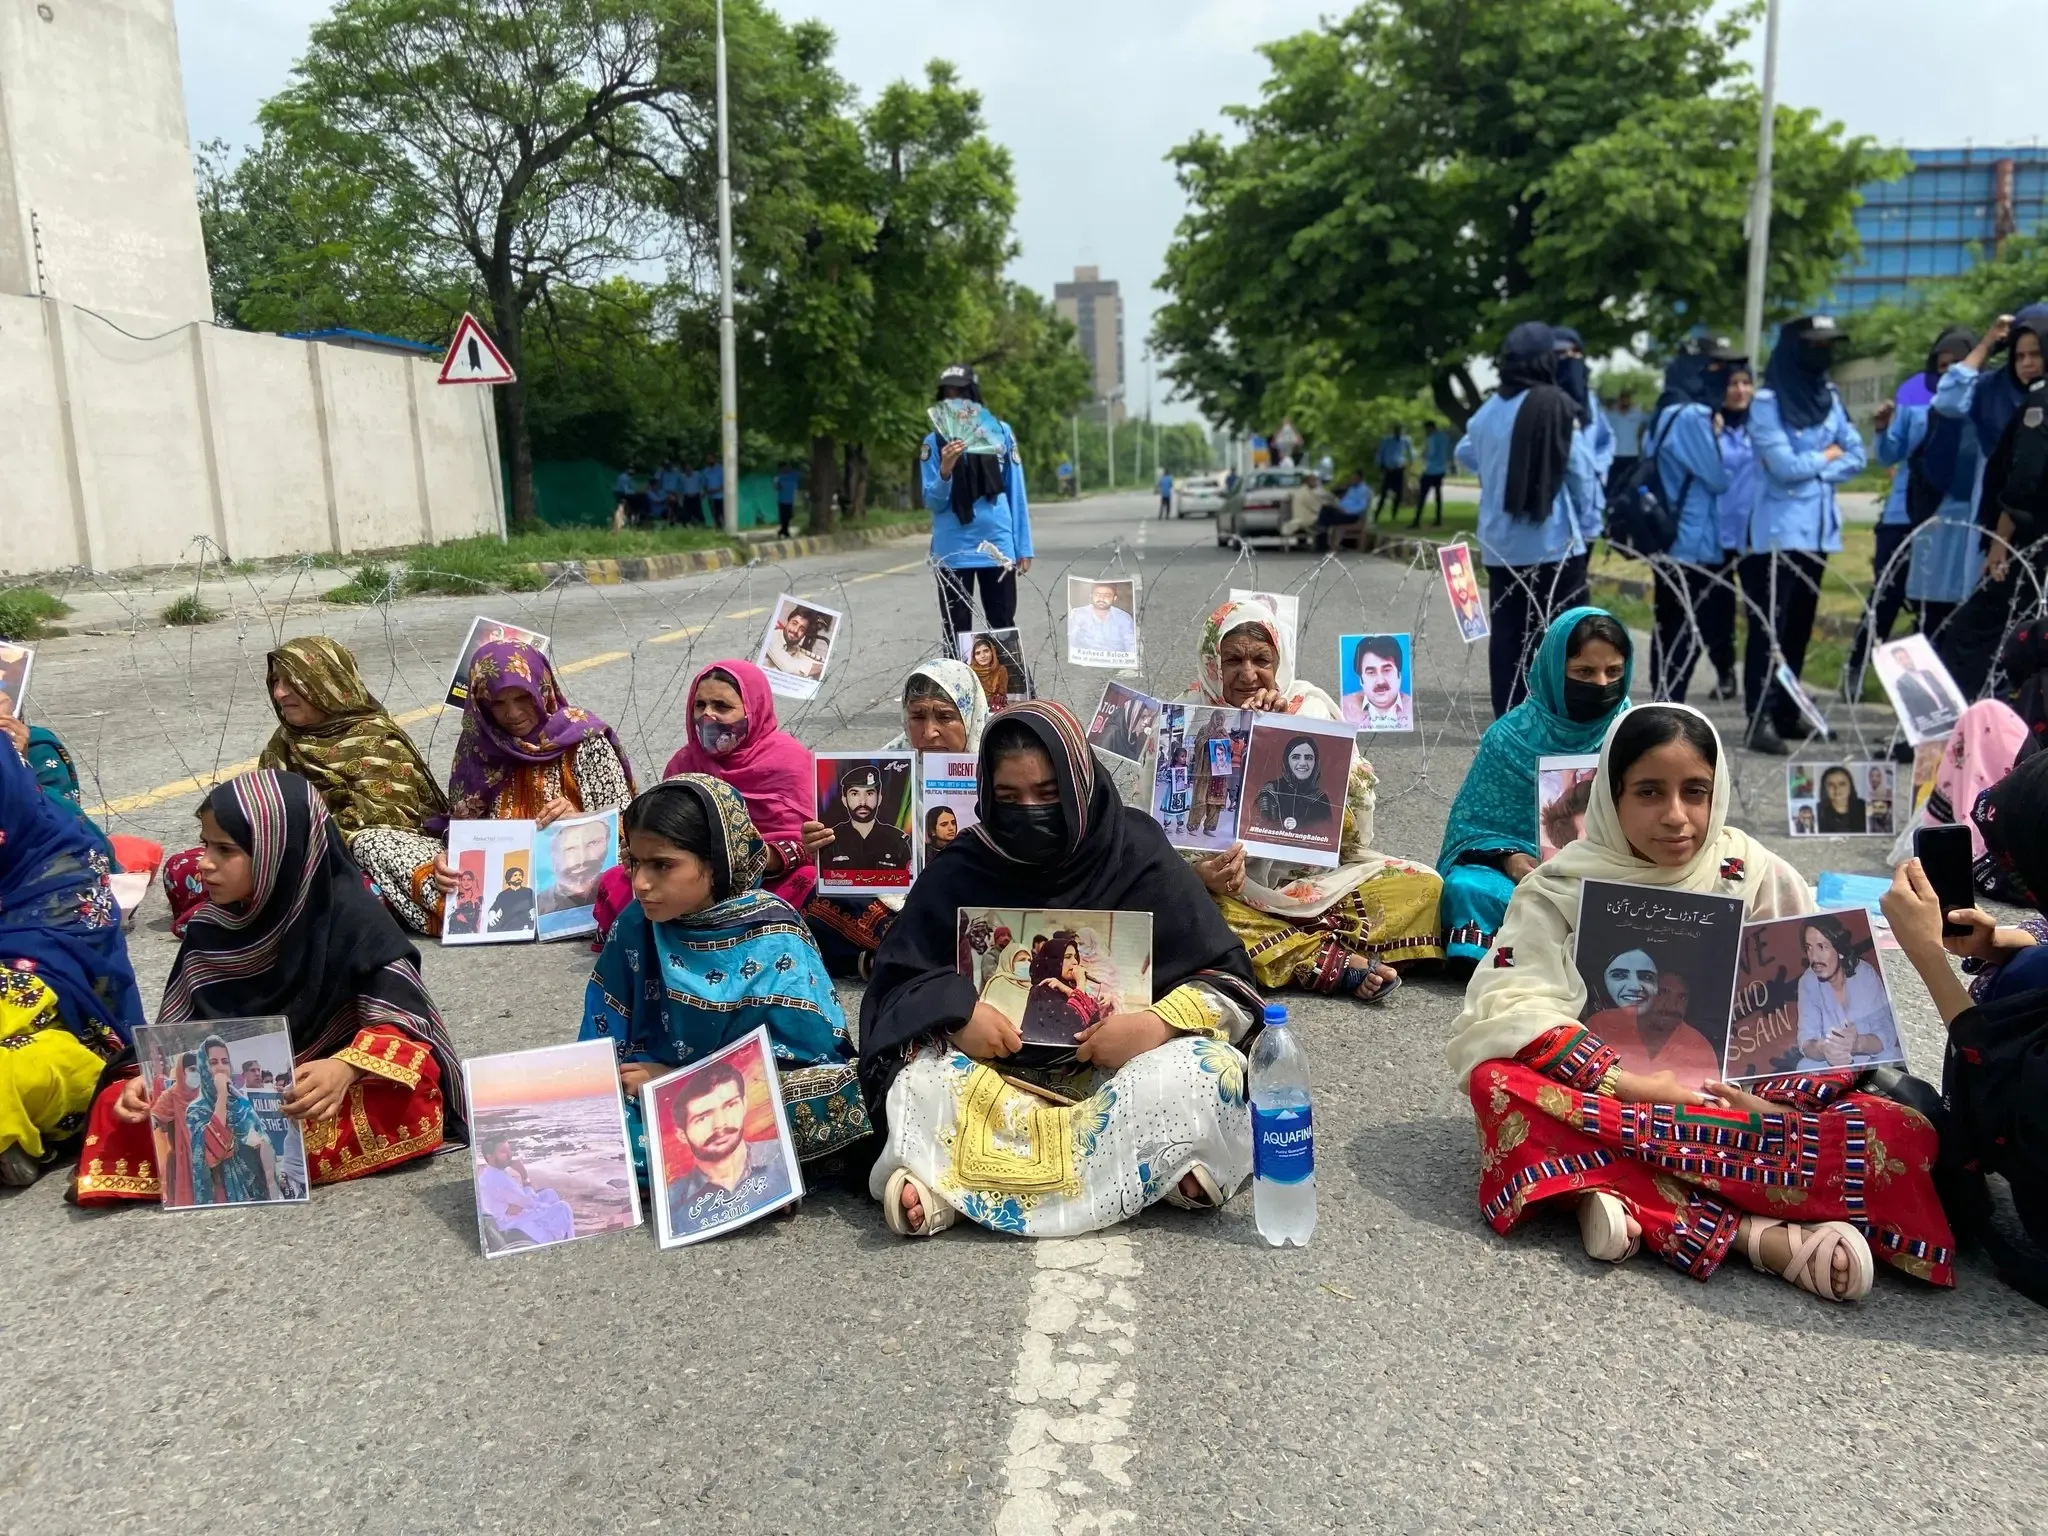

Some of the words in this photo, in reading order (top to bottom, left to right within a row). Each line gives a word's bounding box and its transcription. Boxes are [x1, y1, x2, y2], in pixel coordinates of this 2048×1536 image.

[1077, 649, 1104, 657] Rasheed
[948, 762, 974, 777] URGENT
[1249, 826, 1329, 842] #ReleaseMahrangBaloch
[253, 1098, 281, 1111] KILLING
[267, 1118, 283, 1131] THE
[1263, 1125, 1313, 1147] AQUAFINA
[700, 1202, 750, 1229] 3.5.2016
